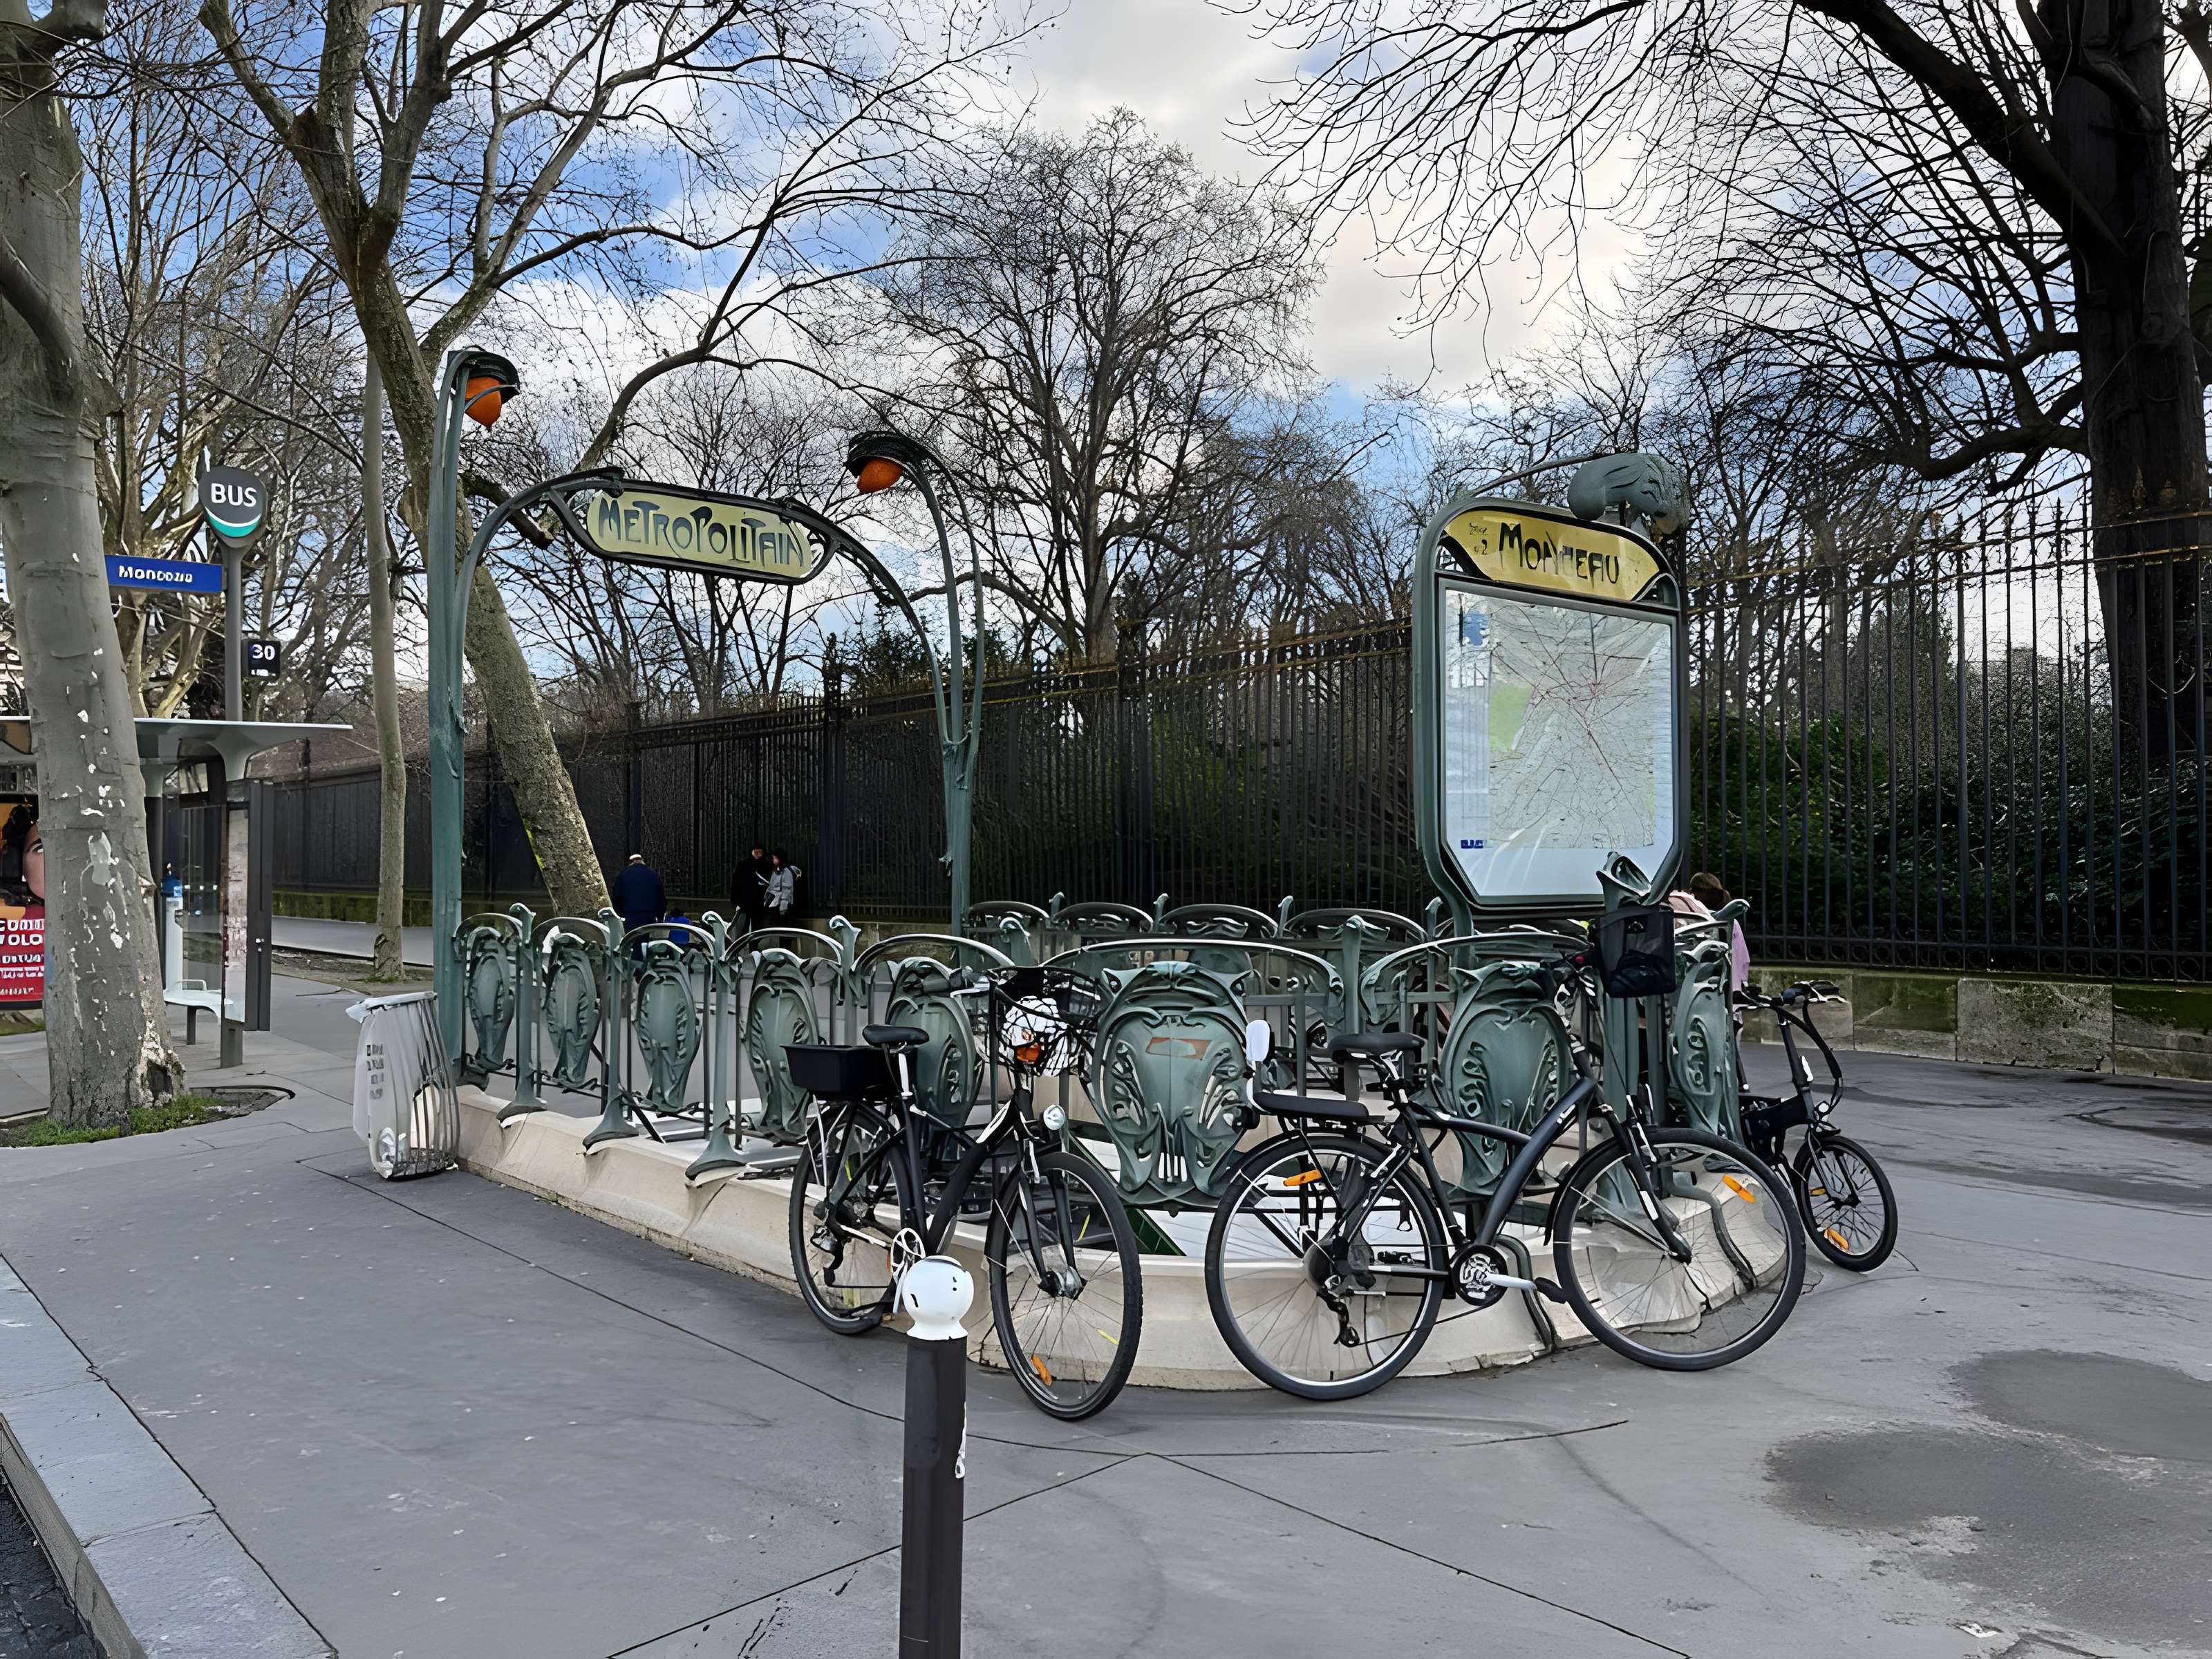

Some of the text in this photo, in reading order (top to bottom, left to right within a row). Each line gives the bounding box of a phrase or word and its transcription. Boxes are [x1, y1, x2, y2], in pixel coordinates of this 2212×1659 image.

[211, 482, 257, 507] BUS
[598, 496, 804, 568] METROPOLITAIN
[252, 644, 276, 661] 30
